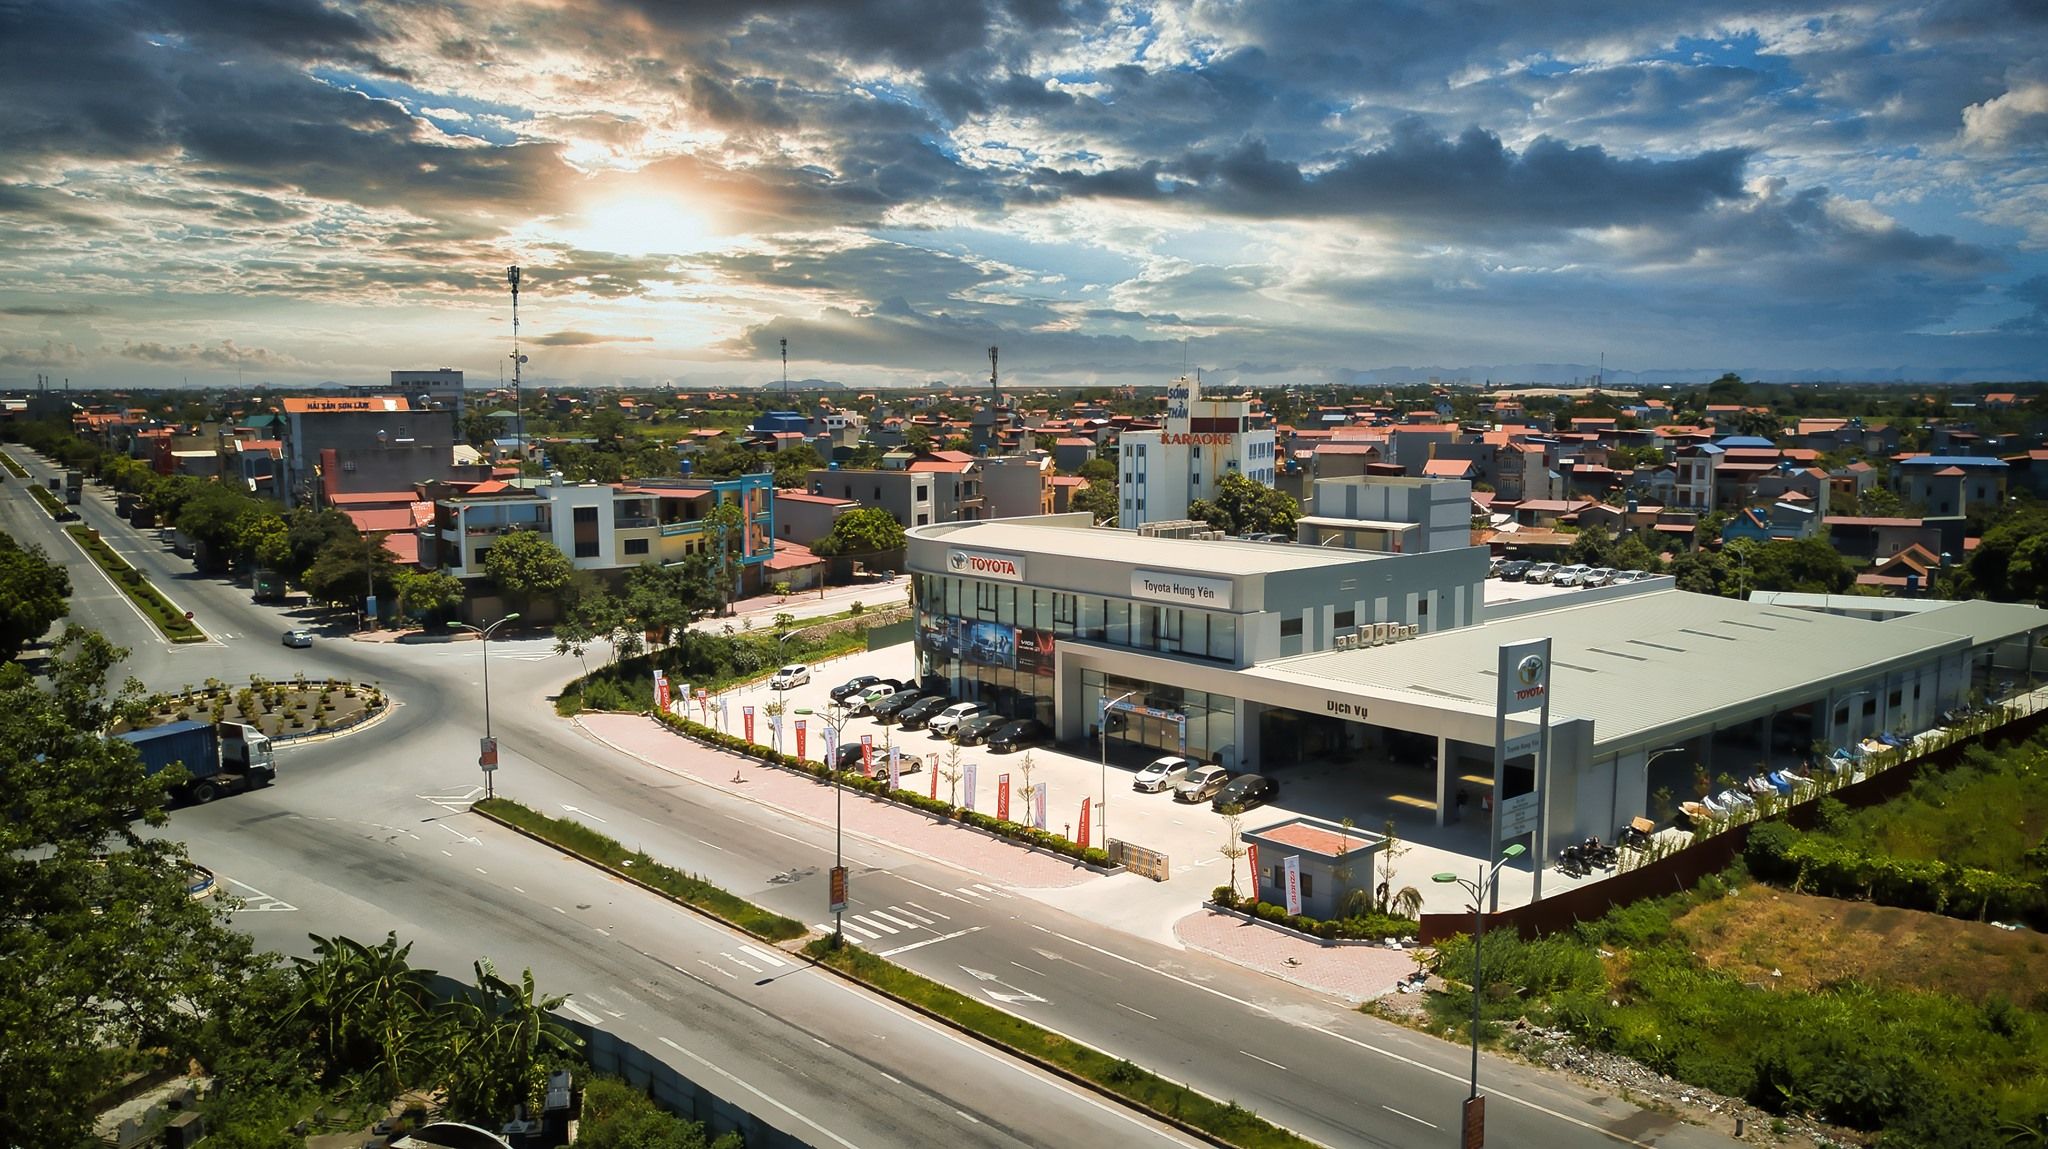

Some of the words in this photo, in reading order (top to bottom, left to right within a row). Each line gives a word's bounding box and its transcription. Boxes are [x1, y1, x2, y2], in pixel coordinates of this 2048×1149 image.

[1161, 433, 1232, 445] KARAOKE
[970, 557, 1016, 575] TOYOTA
[1144, 580, 1171, 594] Toyota
[1173, 584, 1195, 599] Hưng
[1198, 586, 1215, 599] Yên
[1516, 686, 1544, 700] TOYOTA
[1327, 700, 1351, 715] Dịch
[1354, 705, 1368, 720] Vụ
